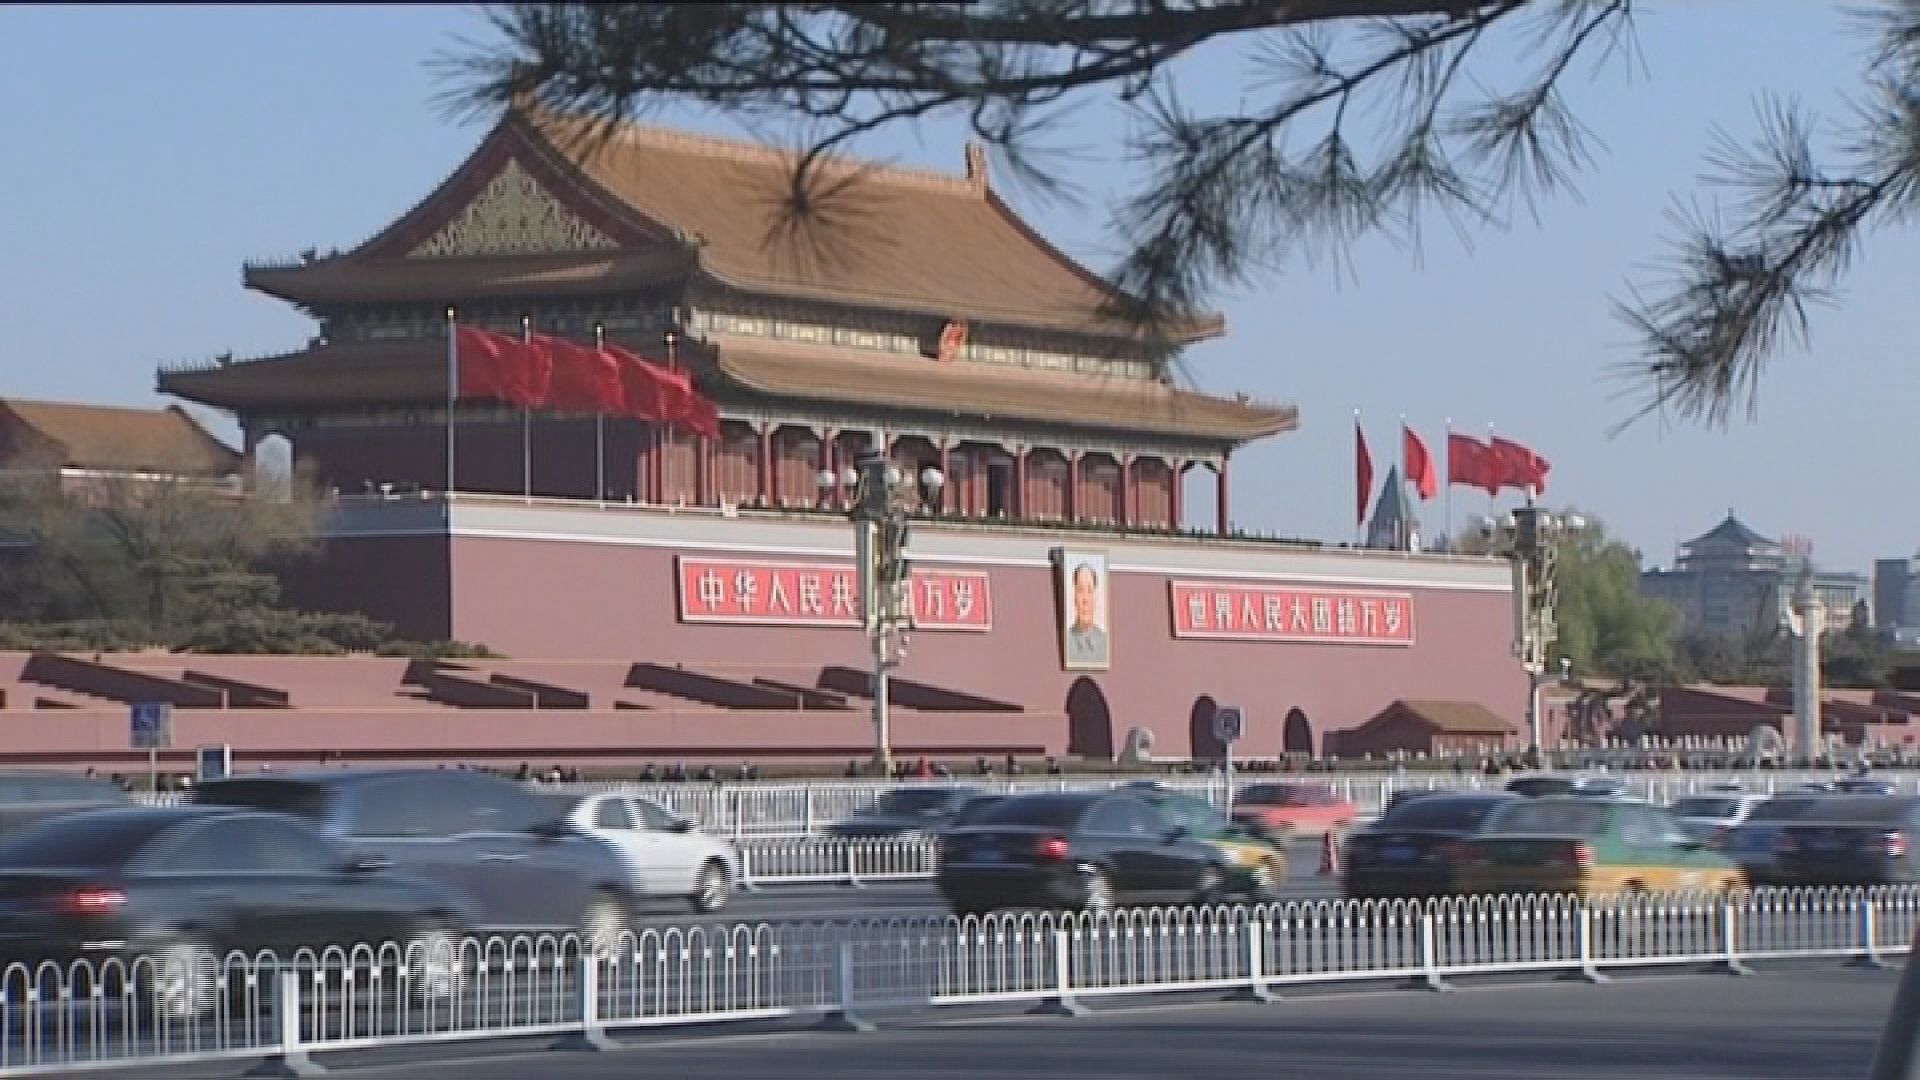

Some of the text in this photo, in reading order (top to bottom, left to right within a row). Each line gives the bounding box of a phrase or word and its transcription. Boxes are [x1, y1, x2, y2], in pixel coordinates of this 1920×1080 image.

[699, 567, 974, 620] 中华人民共万岁
[1189, 592, 1401, 633] 世界人民大团结万岁
